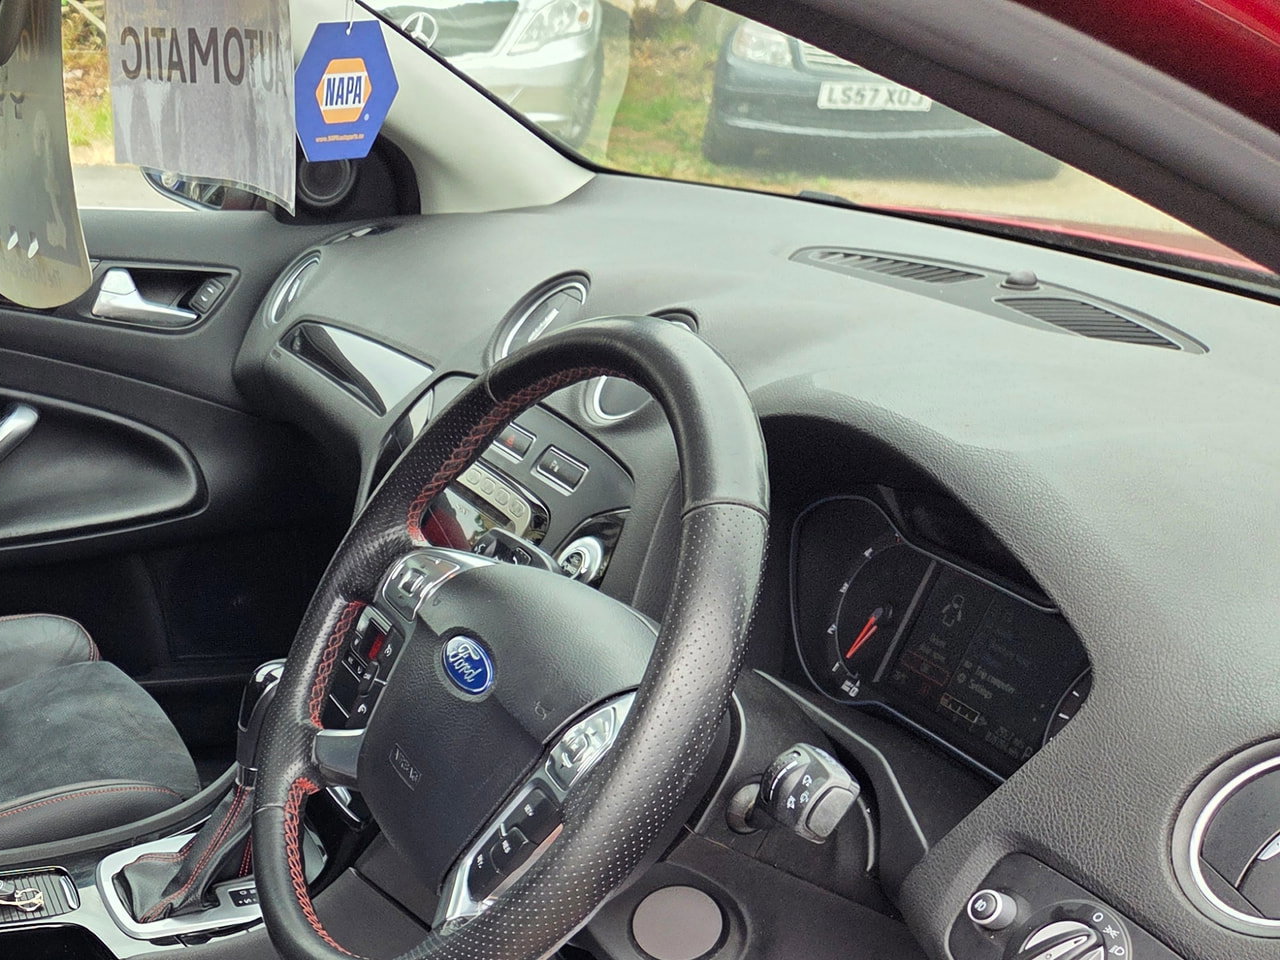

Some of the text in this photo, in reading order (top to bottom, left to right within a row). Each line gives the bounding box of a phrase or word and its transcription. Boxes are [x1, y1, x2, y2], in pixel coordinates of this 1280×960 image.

[325, 76, 363, 106] NAPA
[827, 87, 879, 106] LS57
[448, 643, 483, 683] Ford
